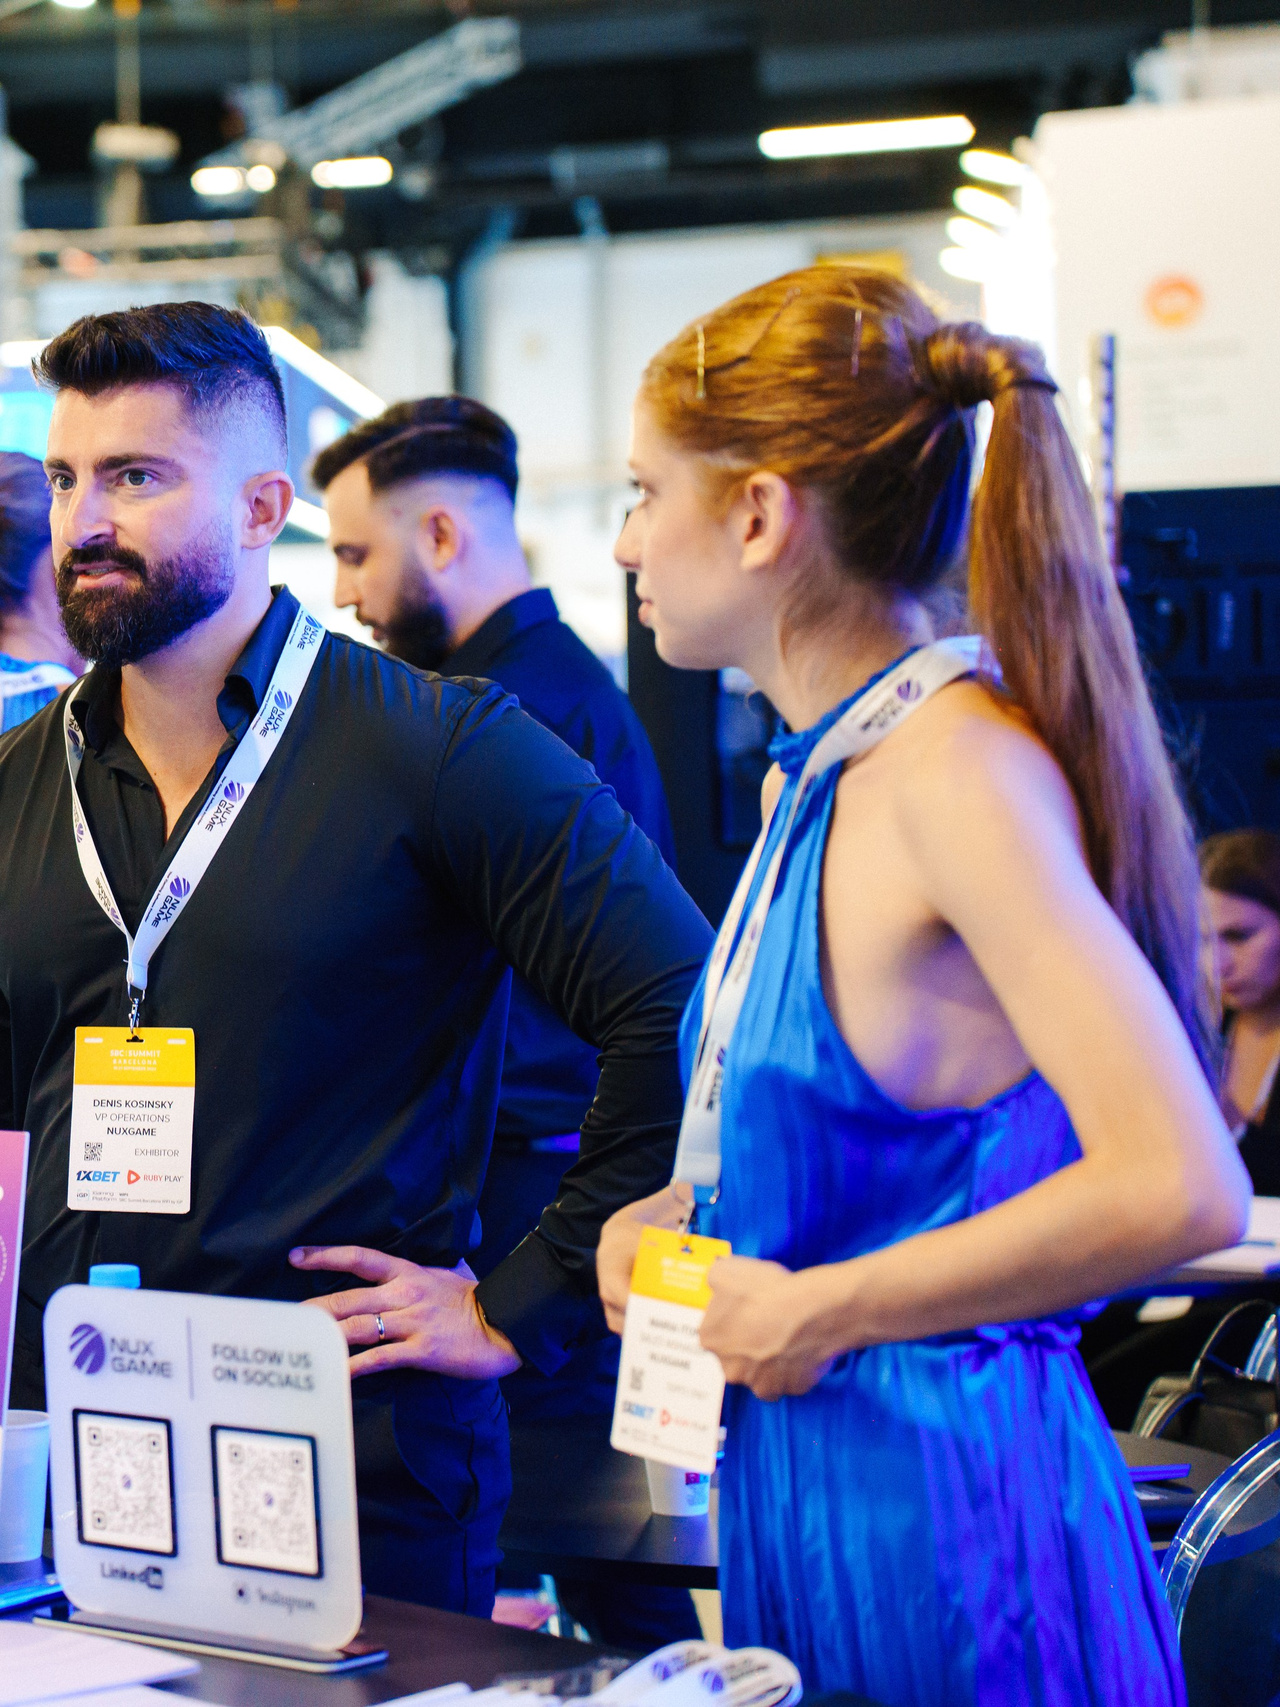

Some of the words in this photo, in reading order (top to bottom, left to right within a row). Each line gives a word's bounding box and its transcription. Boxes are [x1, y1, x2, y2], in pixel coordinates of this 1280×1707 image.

[297, 624, 312, 650] GAME
[306, 627, 319, 647] NUX
[259, 706, 278, 738] GAME
[270, 709, 285, 734] NUX
[205, 799, 227, 832] GAME
[216, 802, 235, 827] NUX
[151, 895, 173, 928] GAME
[162, 898, 180, 922] NUX
[110, 1049, 124, 1057] SBC
[128, 1050, 161, 1058] SUMMIT
[93, 1099, 122, 1108] DENIS
[125, 1099, 174, 1109] KOSINSKY
[95, 1113, 108, 1121] VP
[109, 1113, 171, 1123] OPERATIONS
[106, 1127, 157, 1137] NUXGAME
[134, 1148, 180, 1157] EXHIBITOR
[76, 1170, 120, 1182] 1XBET
[111, 1337, 153, 1356] NUX
[212, 1343, 284, 1365] FOLLOW
[288, 1351, 312, 1369] US
[111, 1356, 173, 1379] GAME
[213, 1365, 238, 1382] ON
[242, 1368, 316, 1392] SOCIALS
